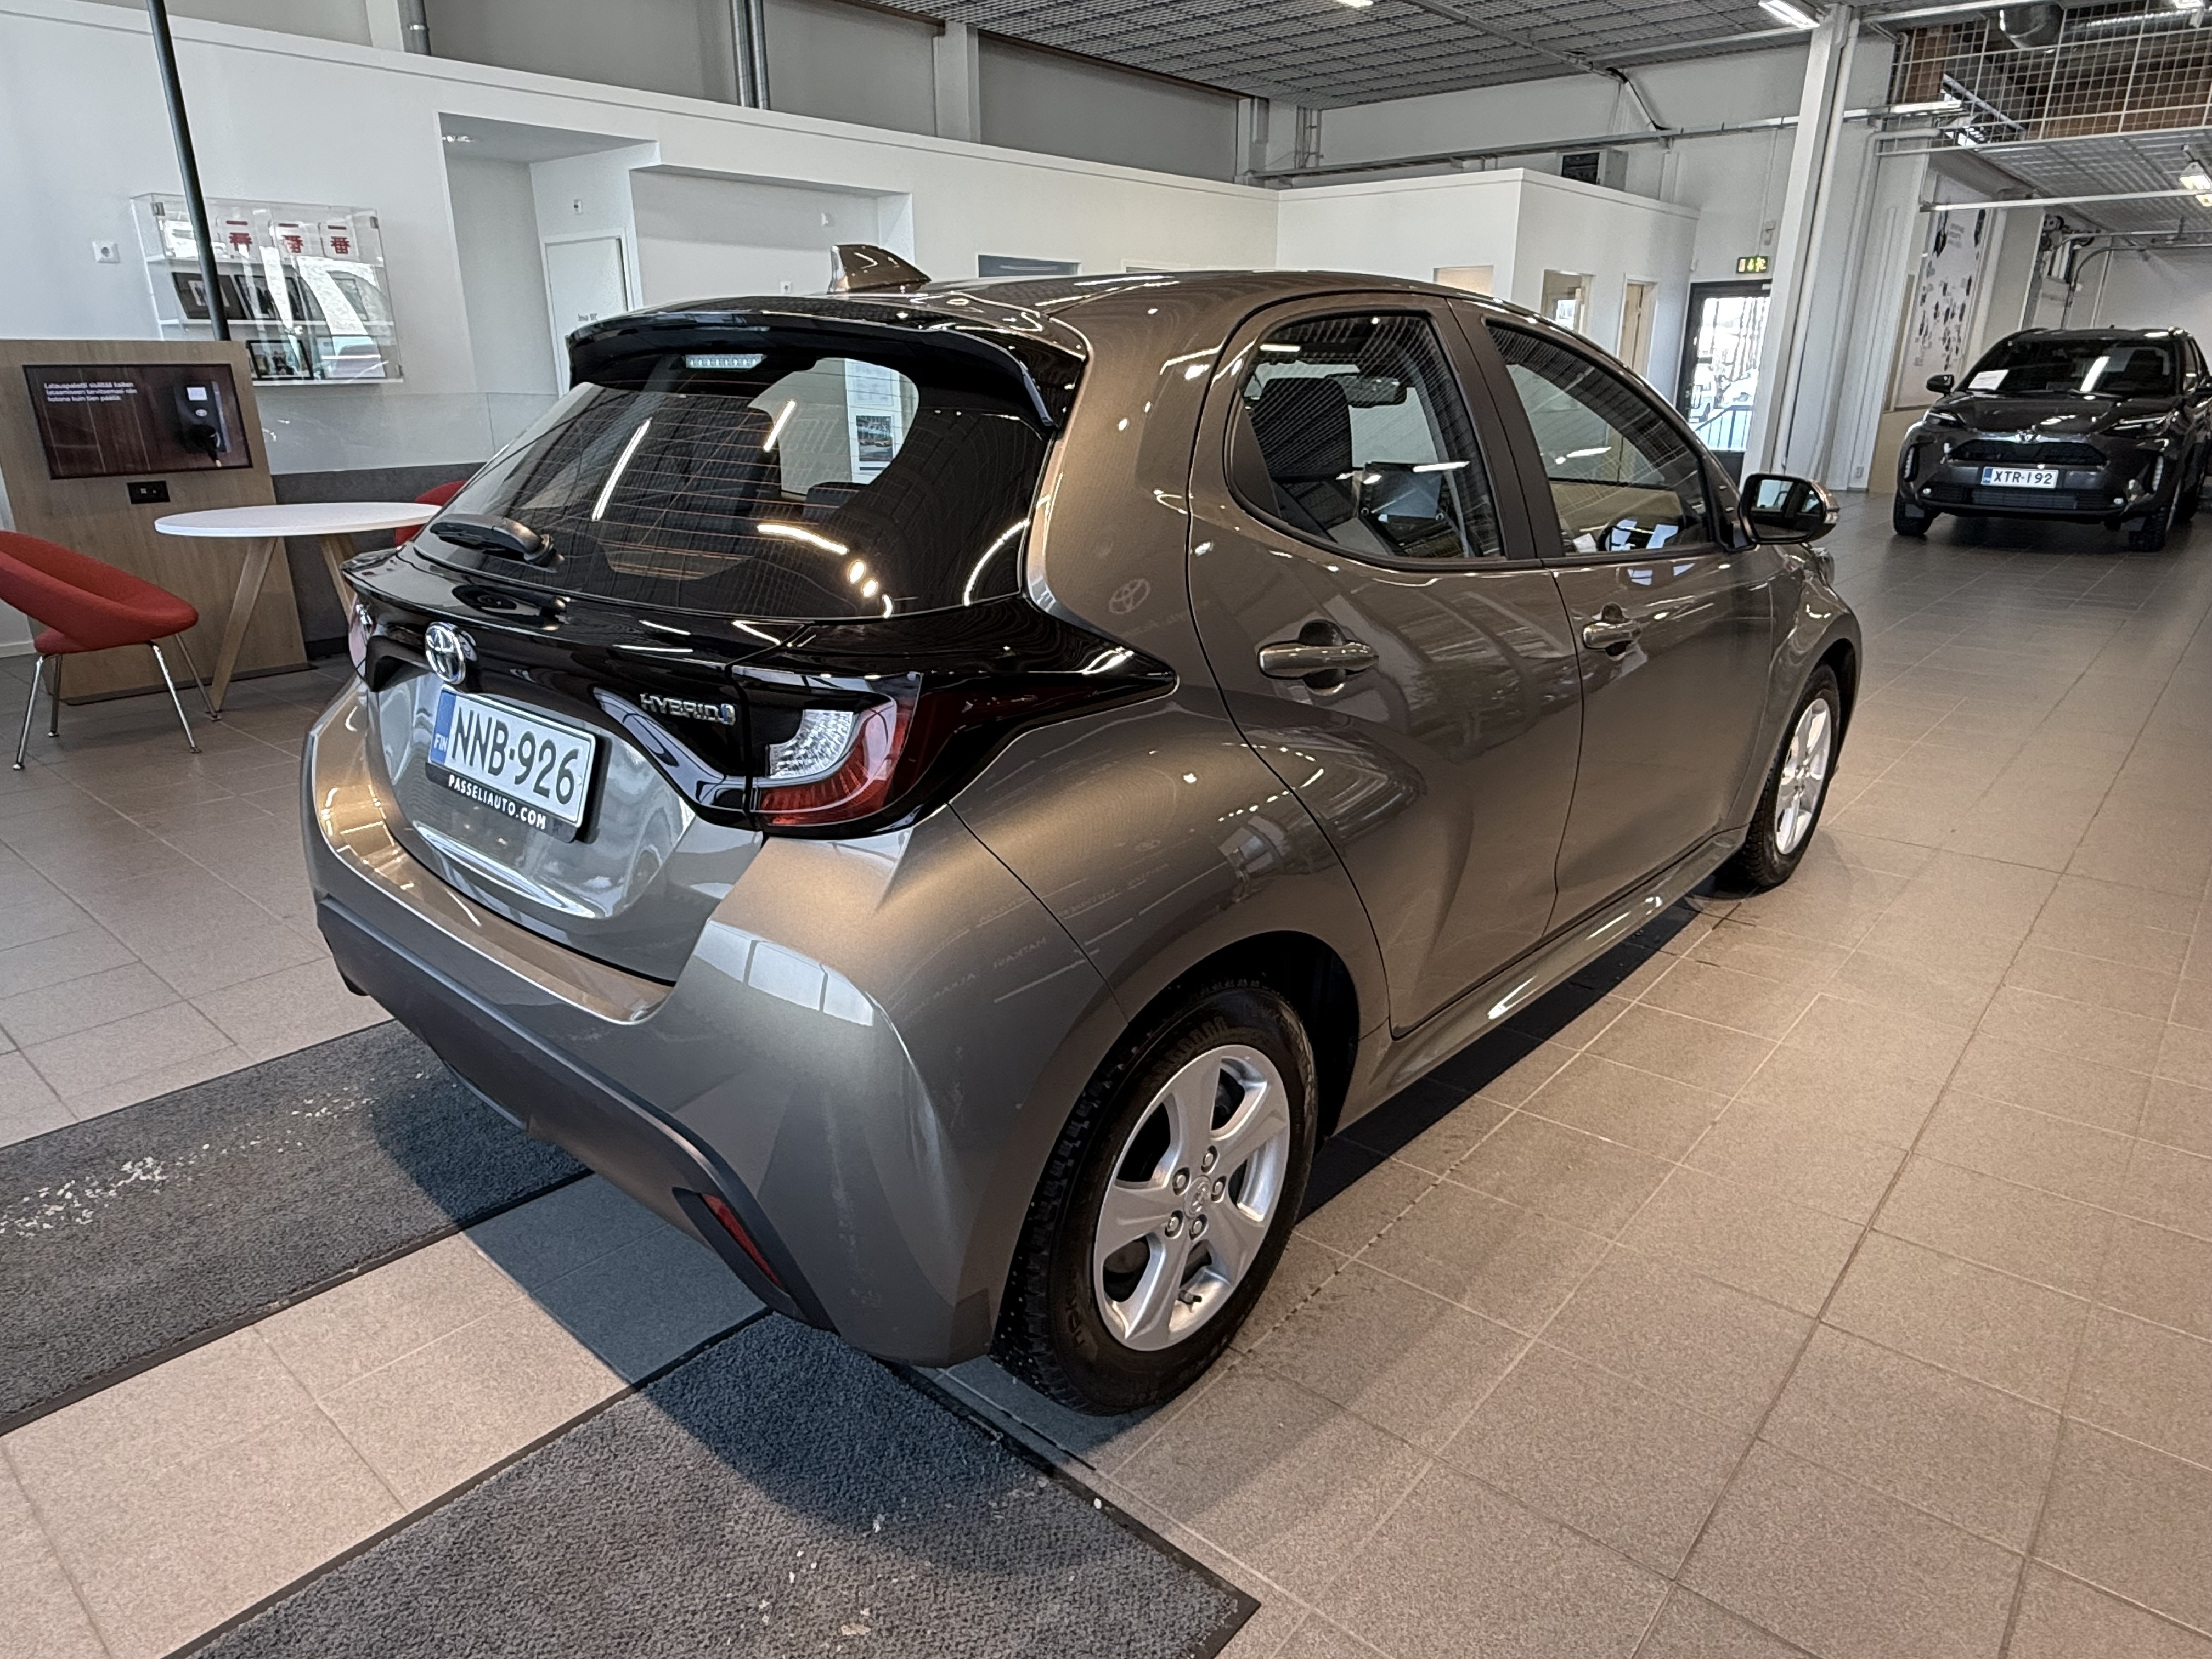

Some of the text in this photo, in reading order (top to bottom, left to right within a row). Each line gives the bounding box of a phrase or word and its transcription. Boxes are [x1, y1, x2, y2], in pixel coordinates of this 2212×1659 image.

[327, 225, 351, 254] 一番
[1994, 471, 2053, 484] XTR-192
[640, 693, 720, 722] HYBRID
[433, 733, 449, 751] FIN
[451, 706, 579, 805] NNB-926
[448, 775, 547, 830] PASSELIAUTO.COM
